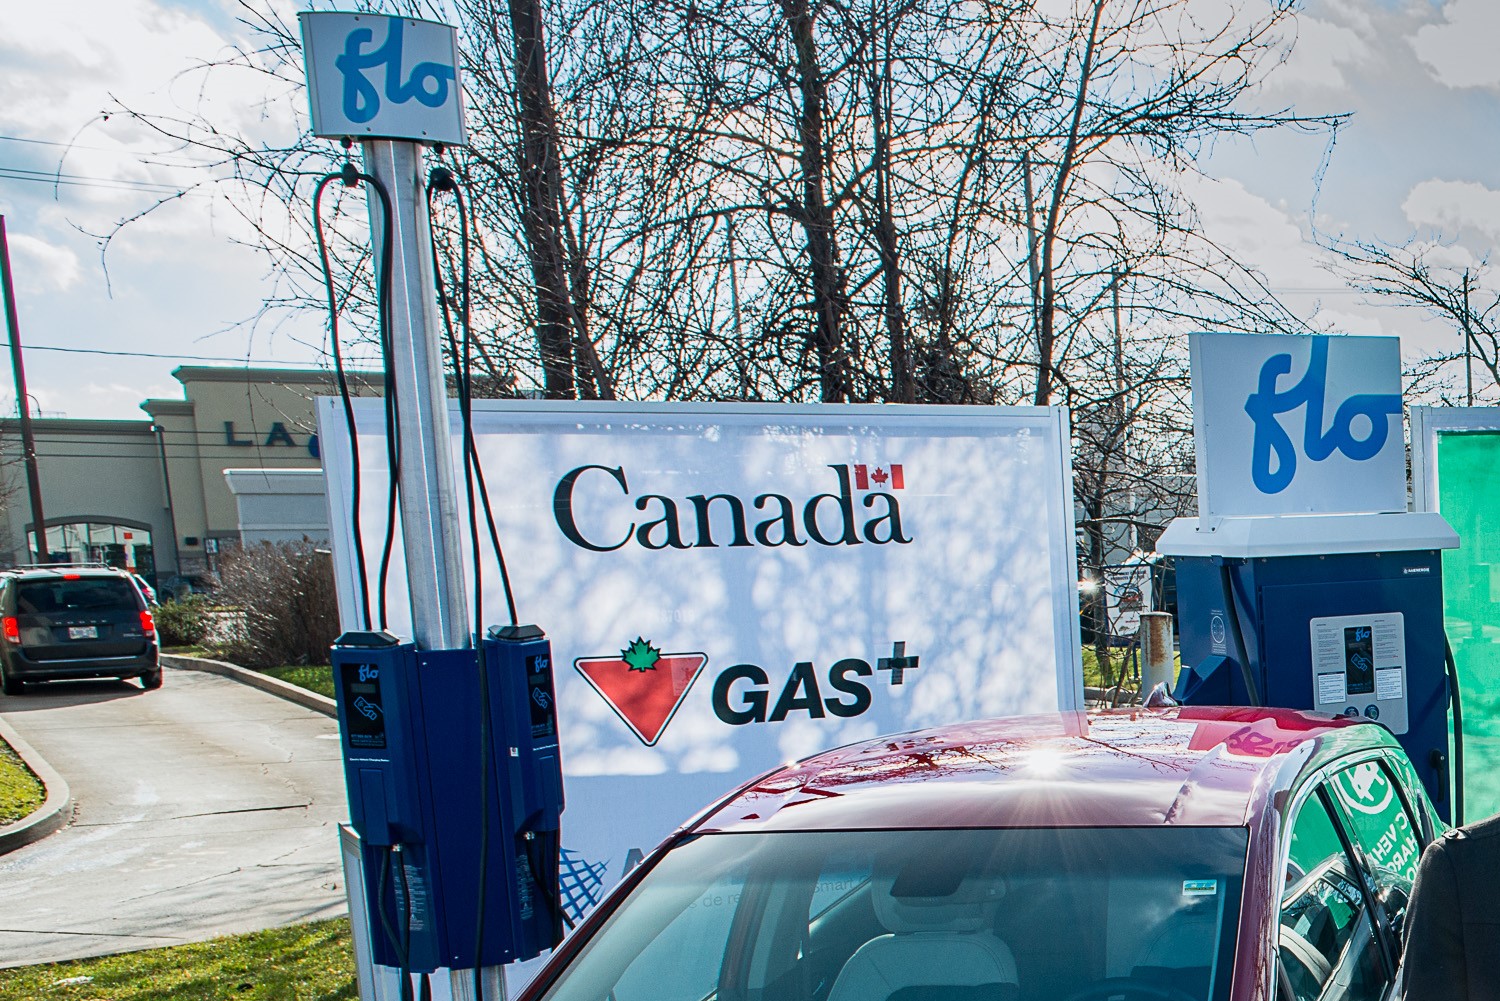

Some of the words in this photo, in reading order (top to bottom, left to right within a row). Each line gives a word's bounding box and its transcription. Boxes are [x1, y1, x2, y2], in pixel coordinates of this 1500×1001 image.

[336, 17, 456, 123] flo
[1244, 336, 1403, 494] flo
[552, 463, 914, 552] Canada
[358, 664, 379, 682] flo
[534, 655, 549, 673] flo
[1355, 628, 1371, 642] flo
[711, 640, 920, 726] GAS+
